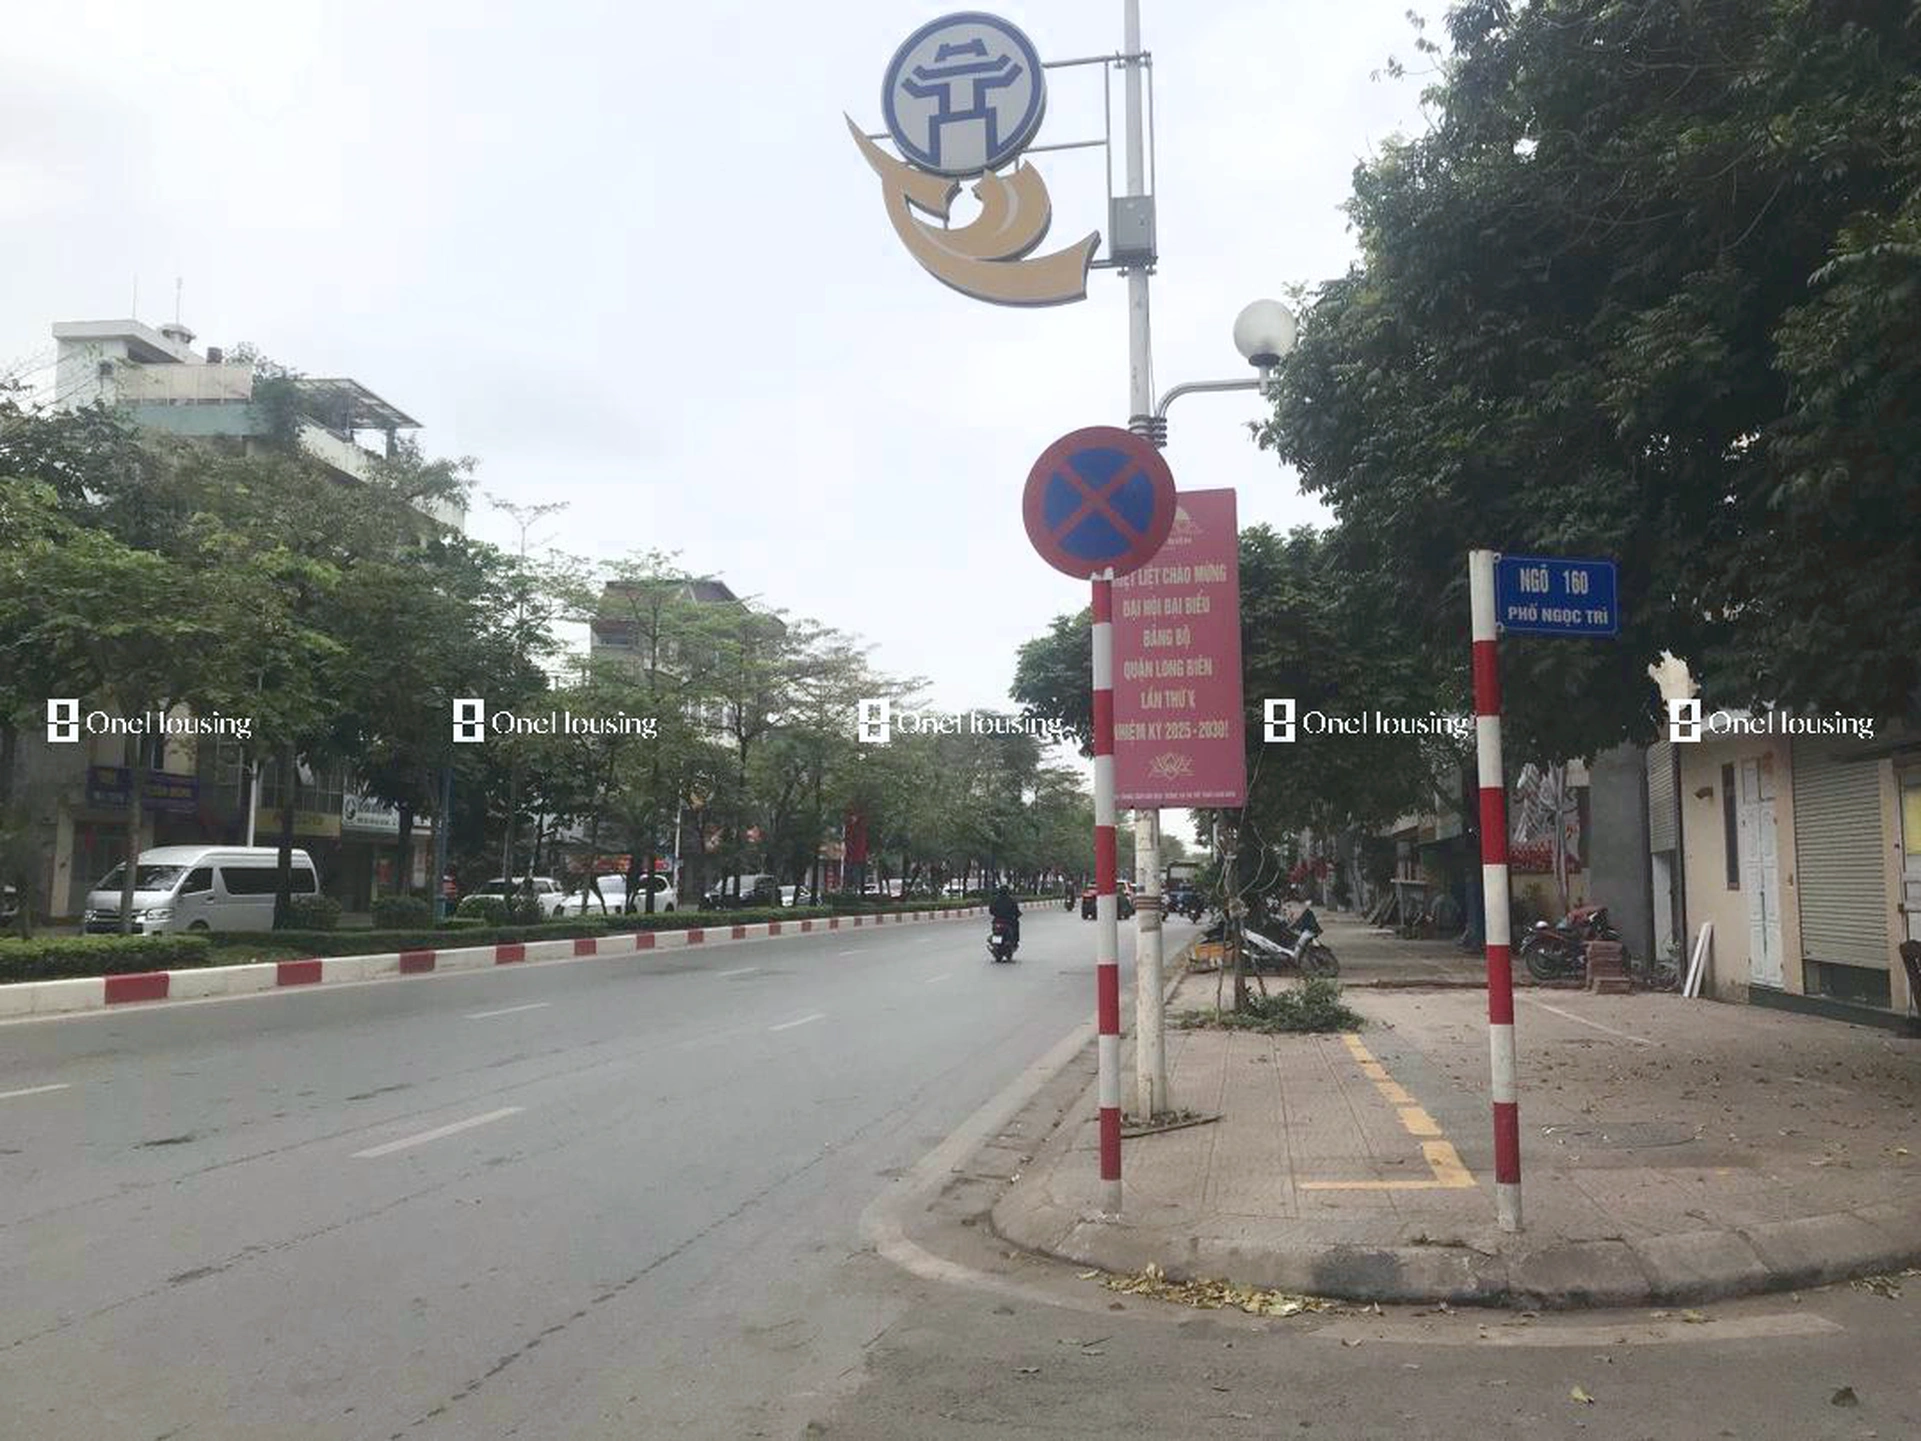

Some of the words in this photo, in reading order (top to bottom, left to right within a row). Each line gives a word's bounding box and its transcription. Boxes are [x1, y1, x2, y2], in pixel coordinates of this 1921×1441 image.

[1162, 563, 1191, 584] CHÀO
[1520, 564, 1549, 593] NGÕ
[1563, 570, 1588, 594] 160
[1508, 602, 1538, 621] PHỐ
[1541, 608, 1581, 627] NGỌC
[1155, 659, 1184, 678] LONG
[1186, 654, 1212, 677] BIÊN
[1166, 721, 1191, 740] 2025
